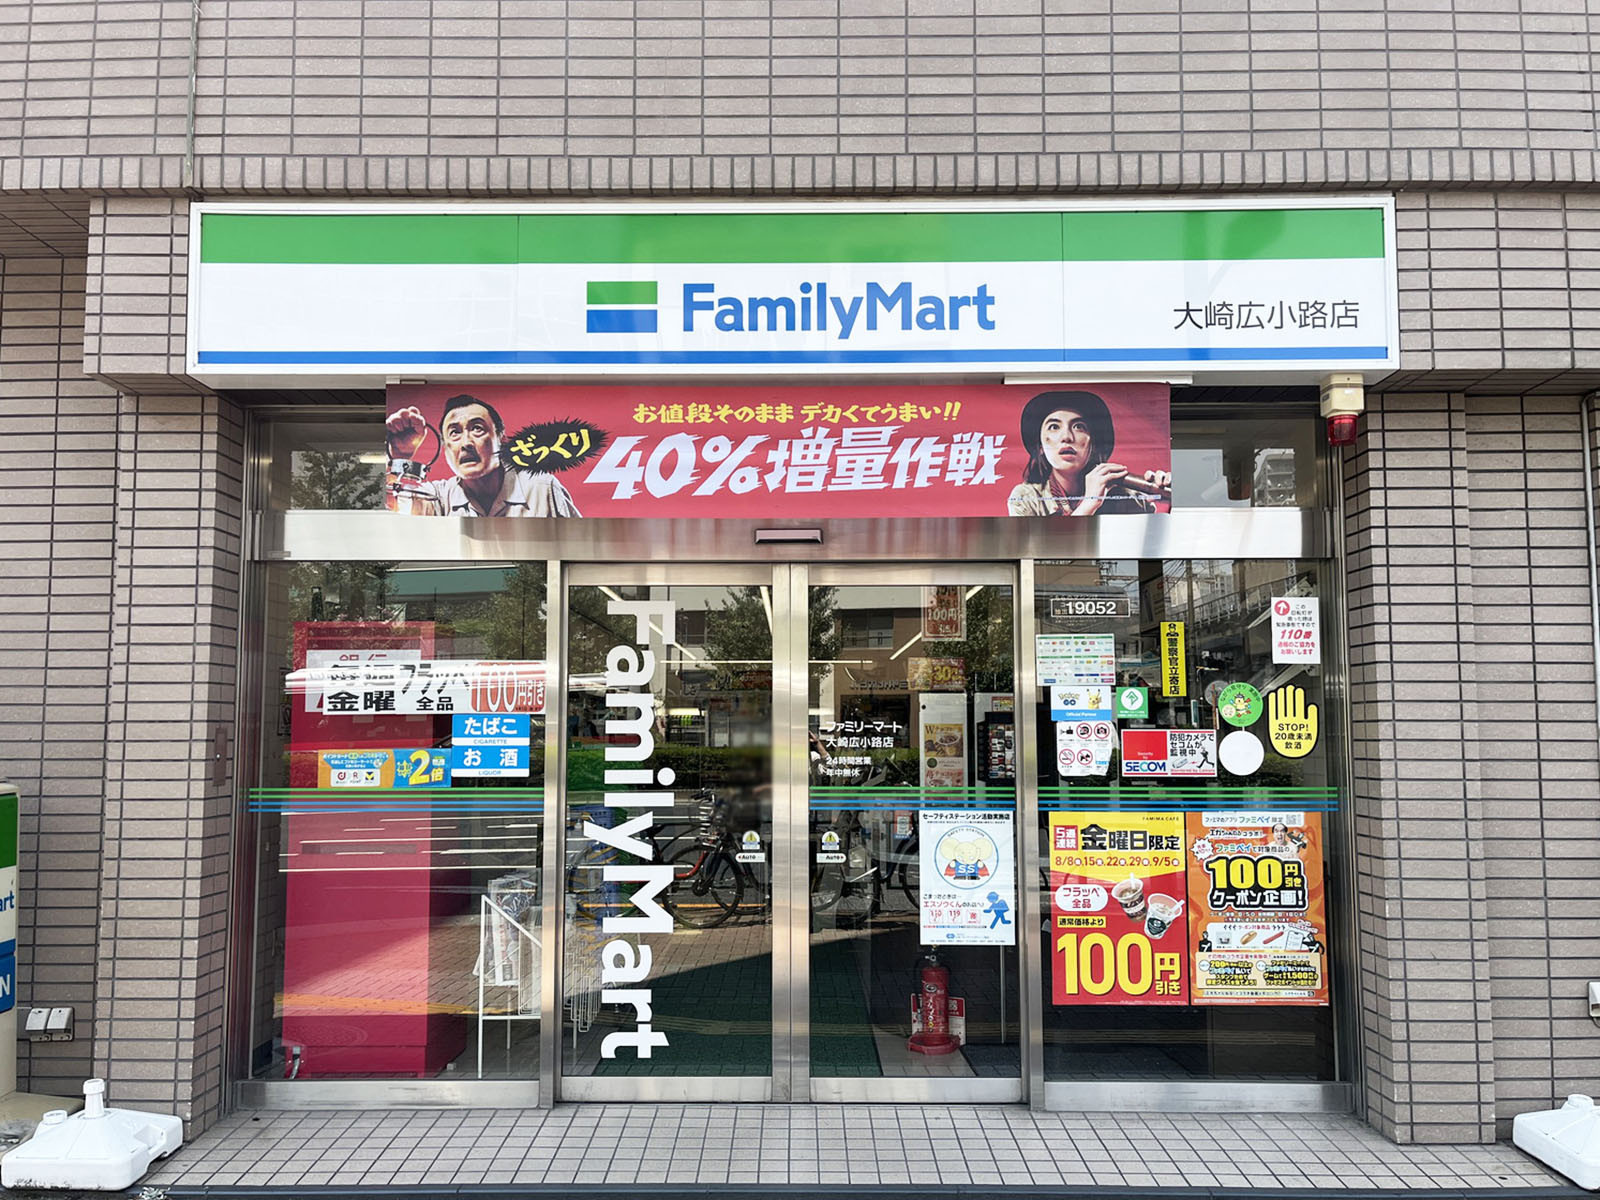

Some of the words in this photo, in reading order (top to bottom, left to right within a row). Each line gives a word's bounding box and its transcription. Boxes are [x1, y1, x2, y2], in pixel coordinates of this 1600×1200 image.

[682, 281, 996, 340] FamilyMart
[1173, 299, 1360, 330] 大崎広小路店
[633, 402, 794, 424] お値段そのまま
[1065, 601, 1117, 615] 19052
[327, 690, 396, 712] 金曜
[416, 696, 454, 712] 全品
[464, 717, 518, 735] たばこ
[825, 721, 903, 734] ファミリーマート
[1277, 723, 1310, 732] STOP!
[825, 736, 895, 748] 大崎広小路店
[1169, 733, 1215, 742] 防犯カメラで
[1274, 732, 1313, 741] 20歳未満
[1169, 741, 1203, 749] セコムが
[1284, 741, 1302, 750] 飲酒
[1169, 748, 1197, 757] 監視中
[825, 756, 872, 766] 24時間営業
[1125, 761, 1166, 772] SECOM
[825, 767, 860, 777] 年中無休
[583, 600, 676, 1060] FamilyMart
[1080, 823, 1181, 851] 金曜日限定
[958, 865, 976, 874] SS
[1062, 887, 1100, 897] フラッペ
[1211, 889, 1304, 906] クーポン企画!
[1071, 899, 1092, 909] 全品
[1058, 917, 1105, 927] 通常価格より
